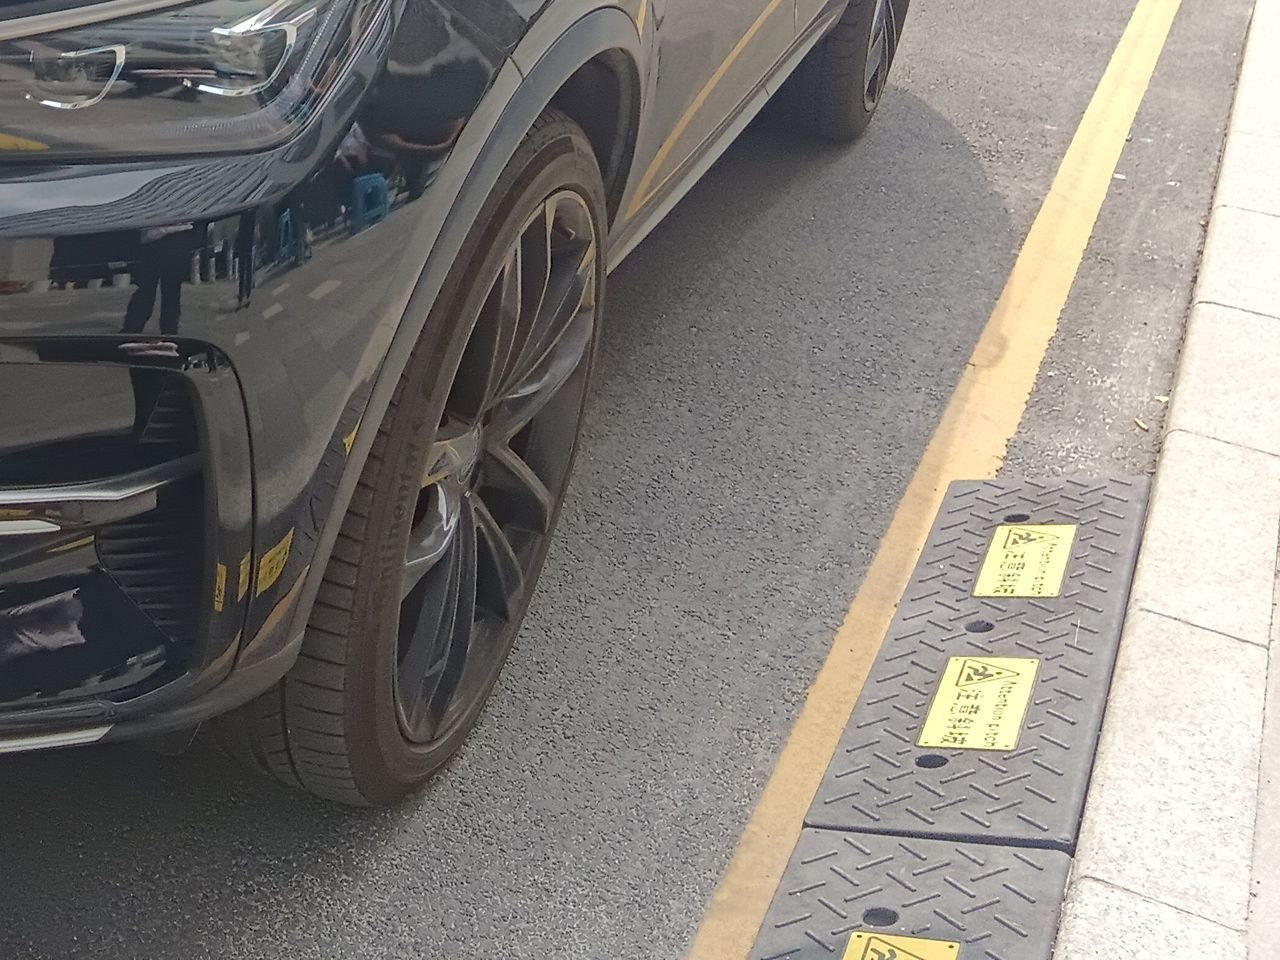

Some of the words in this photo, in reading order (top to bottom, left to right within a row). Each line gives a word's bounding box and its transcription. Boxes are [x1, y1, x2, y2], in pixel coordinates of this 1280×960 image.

[940, 688, 985, 746] 注意斜坡
[991, 680, 1018, 722] Attention
[983, 722, 1000, 748] pitch
